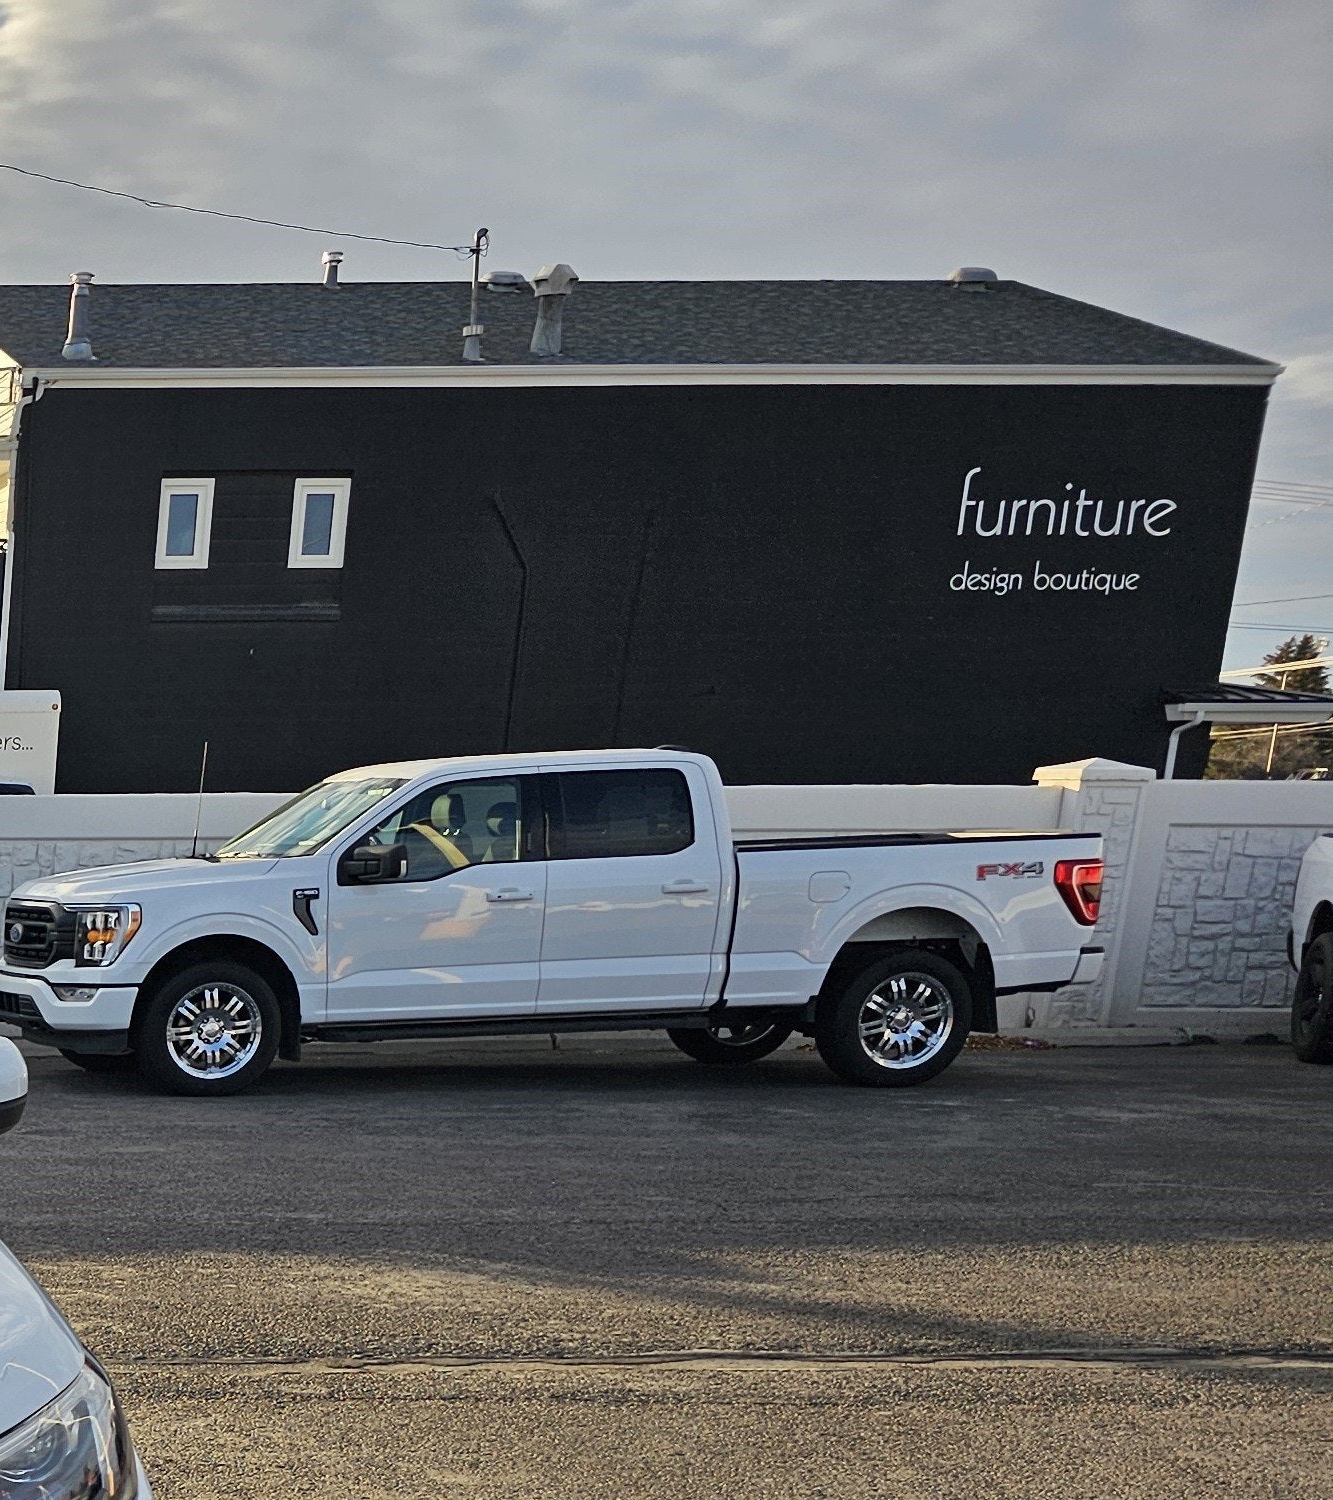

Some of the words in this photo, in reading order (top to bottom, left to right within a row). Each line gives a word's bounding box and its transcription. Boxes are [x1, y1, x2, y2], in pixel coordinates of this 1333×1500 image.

[956, 466, 1177, 537] furniture
[949, 560, 1023, 596] design
[1033, 560, 1141, 596] boutique
[976, 861, 1044, 881] FX4
